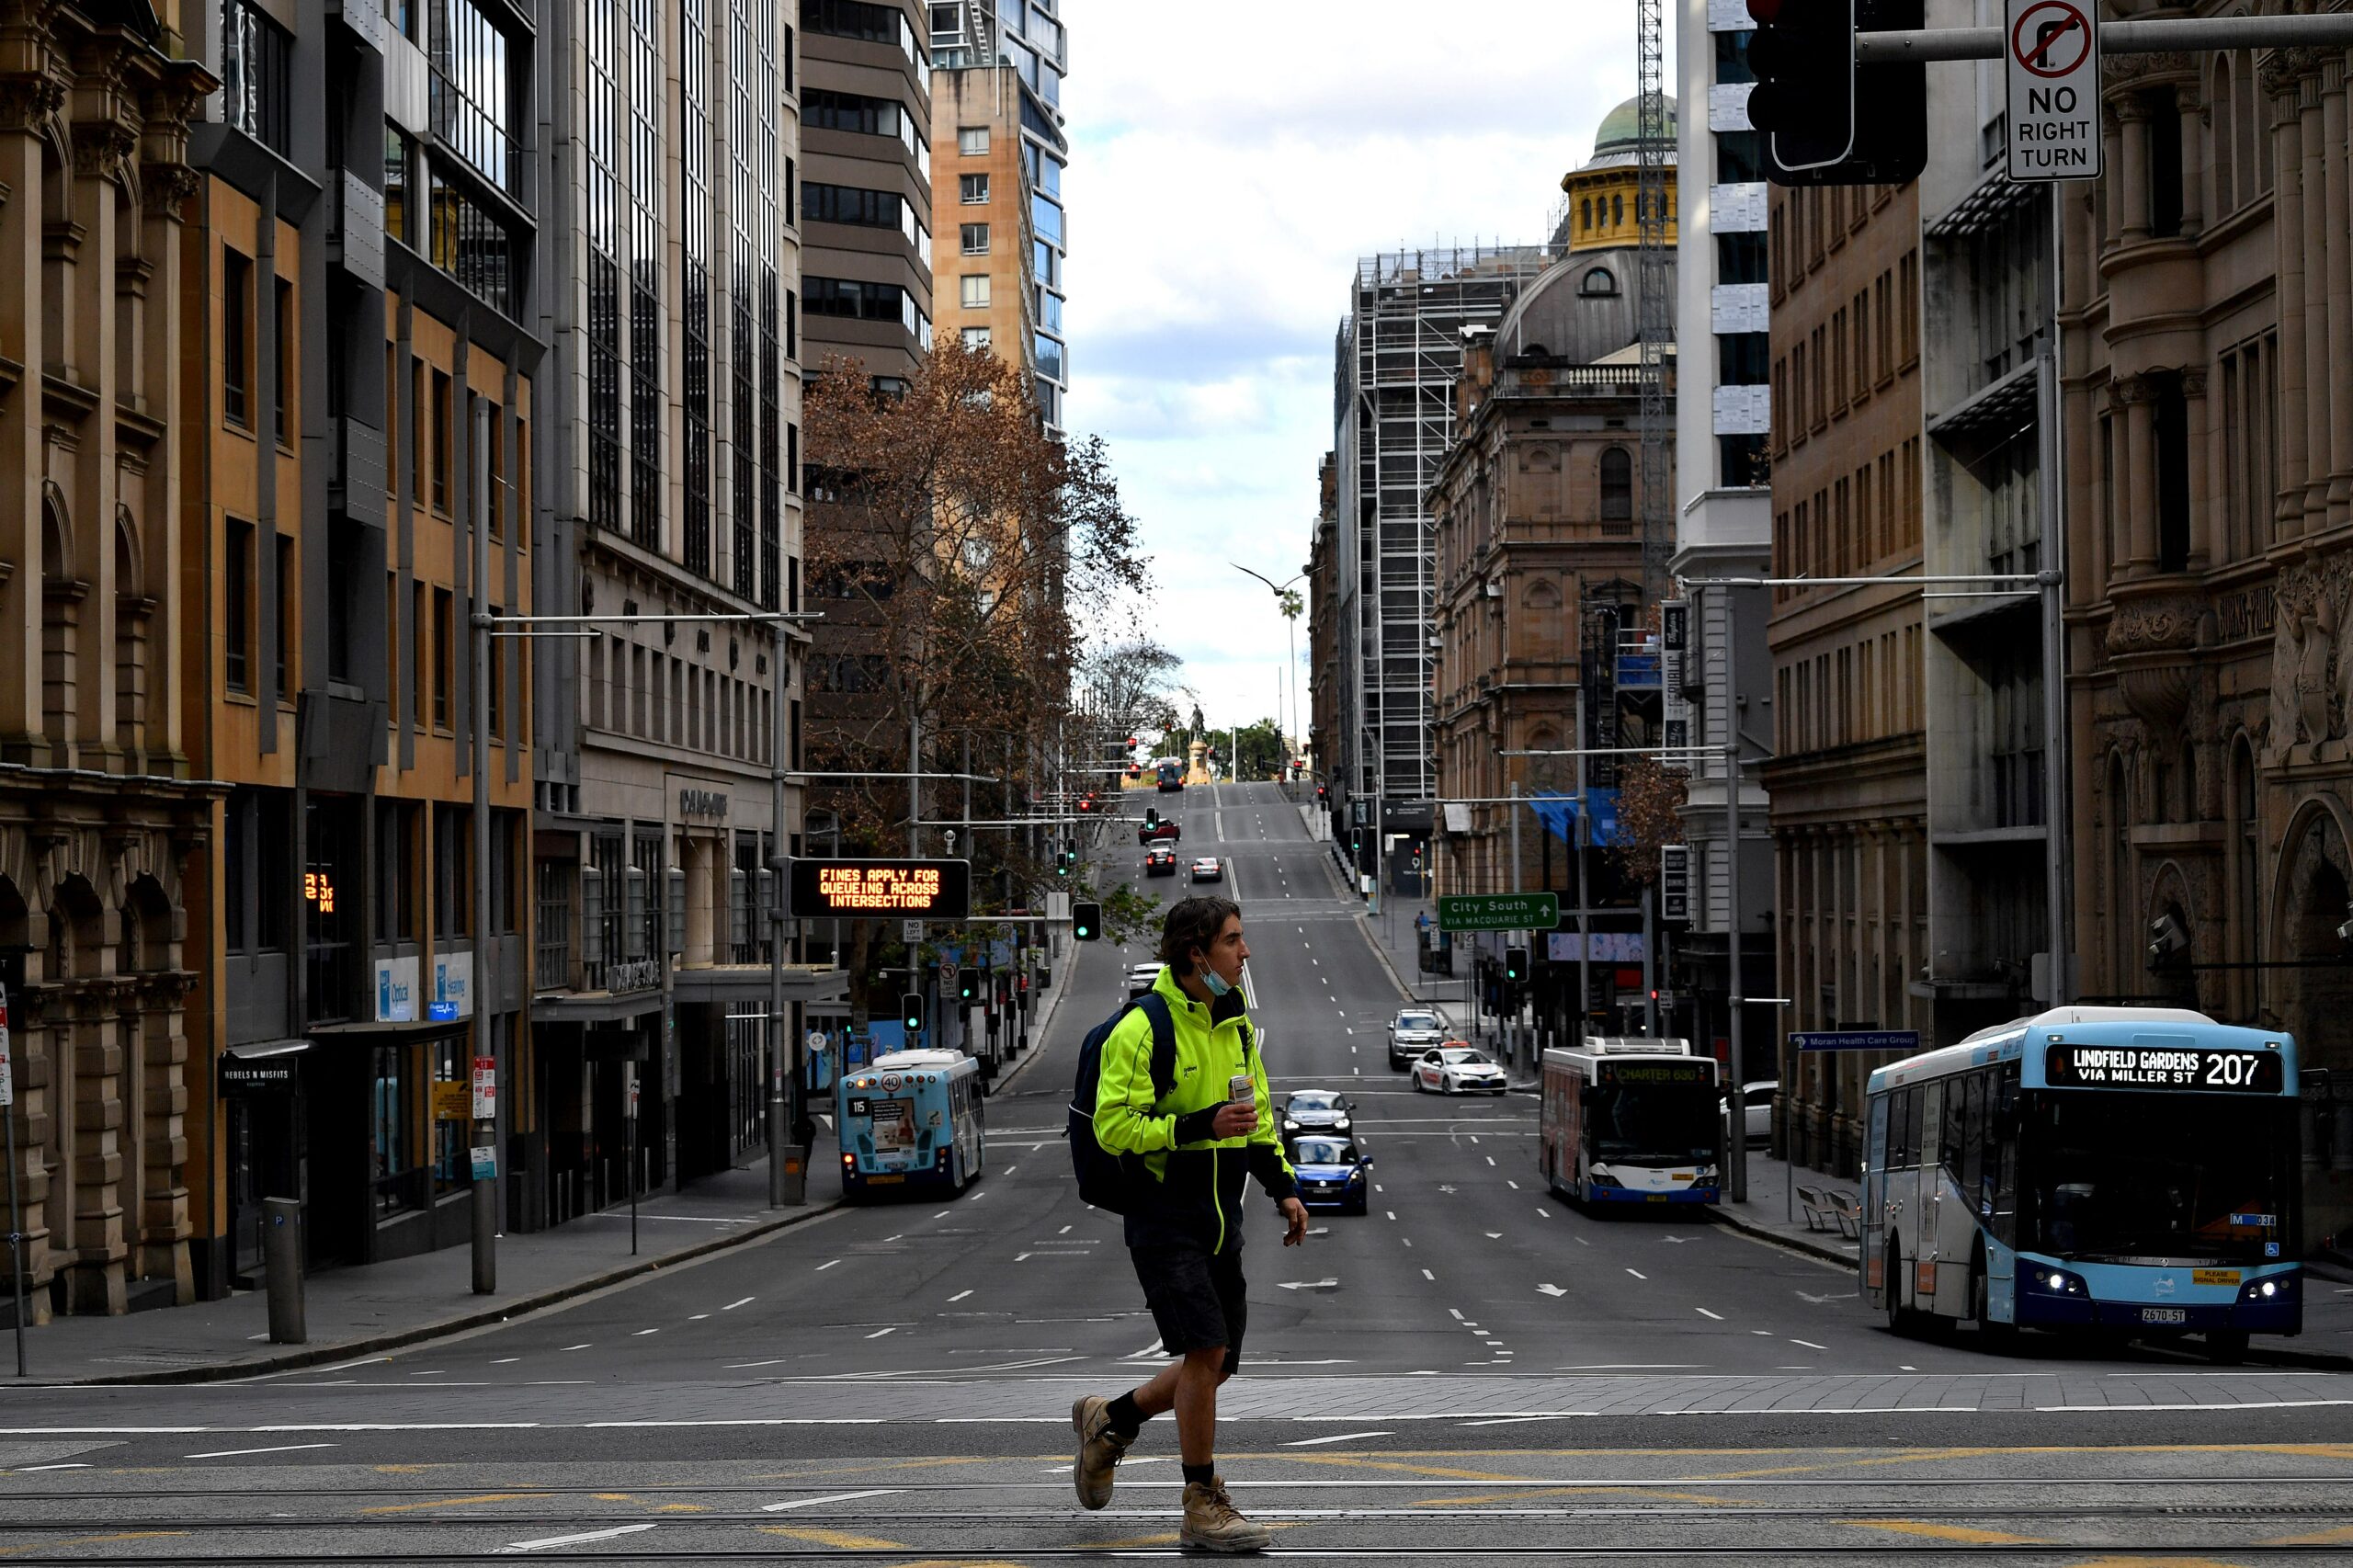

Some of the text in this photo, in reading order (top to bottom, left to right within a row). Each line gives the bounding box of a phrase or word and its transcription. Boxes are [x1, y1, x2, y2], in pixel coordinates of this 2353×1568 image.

[2029, 86, 2077, 114] NO
[2018, 121, 2090, 142] RIGHT
[2020, 147, 2087, 167] TURN
[820, 869, 939, 882] FINES APPLY FOR
[820, 882, 939, 895] QUEUEING ACROSS
[830, 895, 931, 908] INTERSECTIONS
[1450, 900, 1529, 914] City South
[1445, 915, 1534, 926] VIA MACQUARIE ST
[392, 980, 409, 1006] Optical
[1810, 1036, 1916, 1046] Moran Health Care Group
[2074, 1049, 2200, 1071] LINDFIELD GARDENS
[224, 1070, 289, 1080] REBELS N MISFITS
[1618, 1068, 1696, 1081] CHARTER 630
[2206, 1053, 2259, 1085] 207
[883, 1077, 898, 1087] 40
[2078, 1068, 2196, 1084] VIA MILLER ST
[853, 1100, 866, 1114] 115
[2233, 1215, 2244, 1225] M
